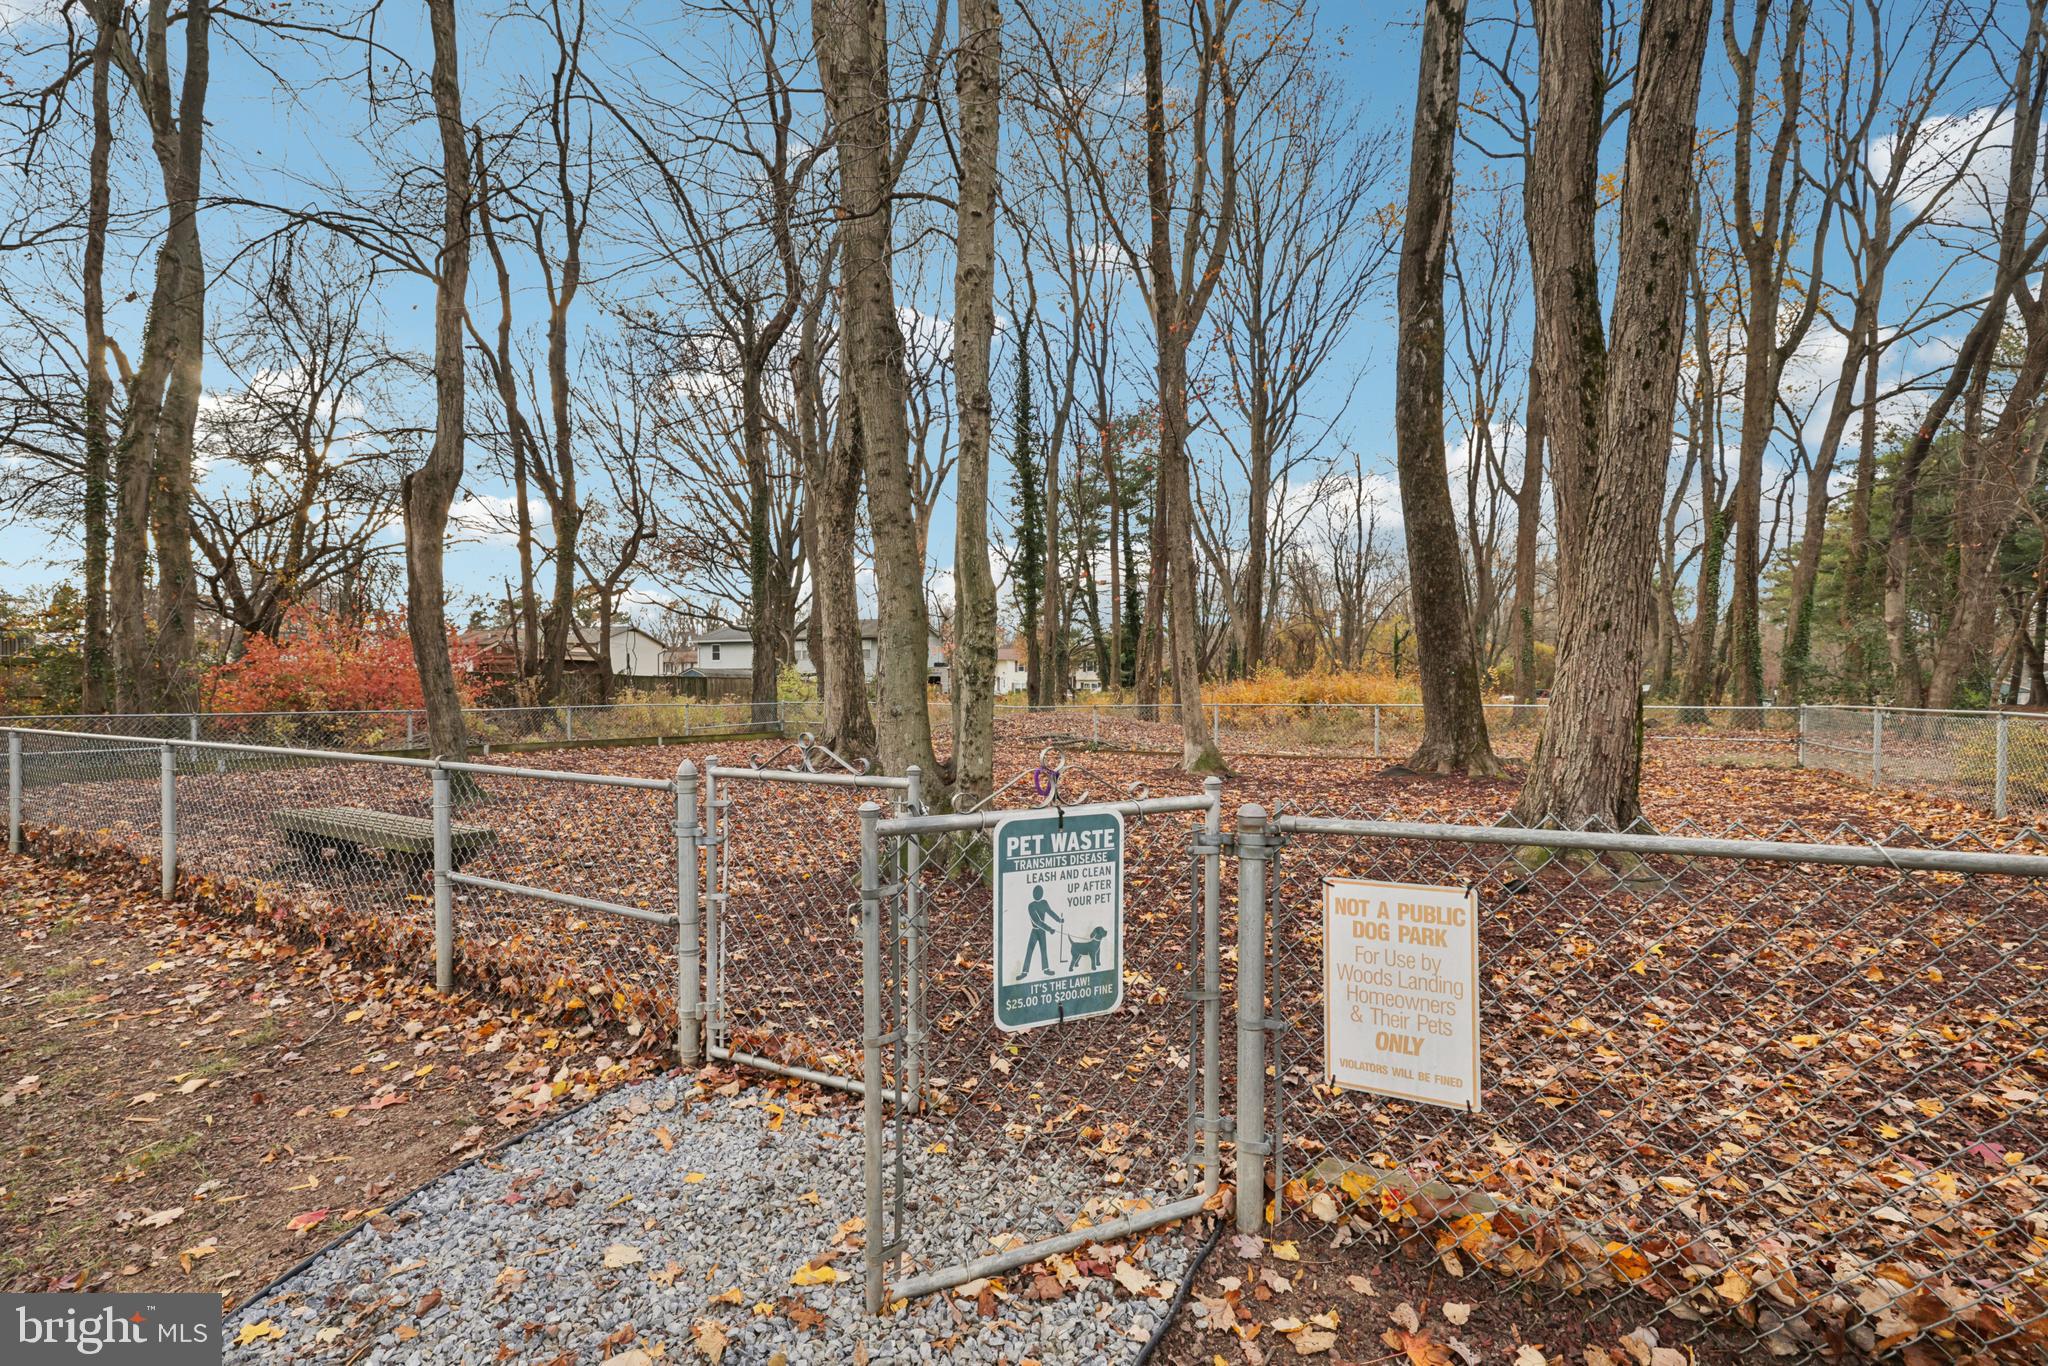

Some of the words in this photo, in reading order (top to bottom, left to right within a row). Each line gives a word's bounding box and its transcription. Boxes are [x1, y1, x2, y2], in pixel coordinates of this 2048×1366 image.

[1007, 835, 1044, 856] PET
[1051, 829, 1115, 852] WASTE
[1014, 856, 1067, 870] TRANSMITS
[1070, 852, 1107, 866] DISEASE
[1026, 871, 1057, 884] LEASH
[1060, 869, 1079, 880] AND
[1082, 866, 1111, 878] CLEAN
[1068, 883, 1080, 893] UP
[1083, 879, 1111, 891] AFTER
[1067, 895, 1091, 908] YOUR
[1094, 893, 1111, 904] PET
[1335, 898, 1370, 916] NOT
[1377, 901, 1390, 920] A
[1398, 903, 1466, 927] PUBLIC
[1353, 921, 1390, 941] DOG
[1398, 925, 1448, 948] PARK
[1355, 946, 1380, 964] For
[1384, 949, 1415, 969] Use
[1422, 953, 1441, 976] by
[1030, 982, 1047, 994] IT'S
[1050, 980, 1066, 992] THE
[1069, 977, 1090, 989] LAW!
[1337, 963, 1392, 987] Woods
[1398, 971, 1464, 1000] Landing
[1006, 997, 1039, 1011] $25.00
[1041, 994, 1052, 1004] TO
[1055, 988, 1091, 1002] $200.00
[1094, 984, 1113, 995] FINE
[1347, 985, 1456, 1016] Homeowners
[1350, 1005, 1363, 1023] &
[1370, 1007, 1409, 1028] Their
[1418, 1014, 1453, 1036] Pets
[1375, 1032, 1425, 1056] ONLY
[1339, 1057, 1388, 1075] VIOLATORS
[1392, 1067, 1415, 1080] WILL
[1418, 1071, 1431, 1082] BE
[1434, 1074, 1463, 1088] FINED
